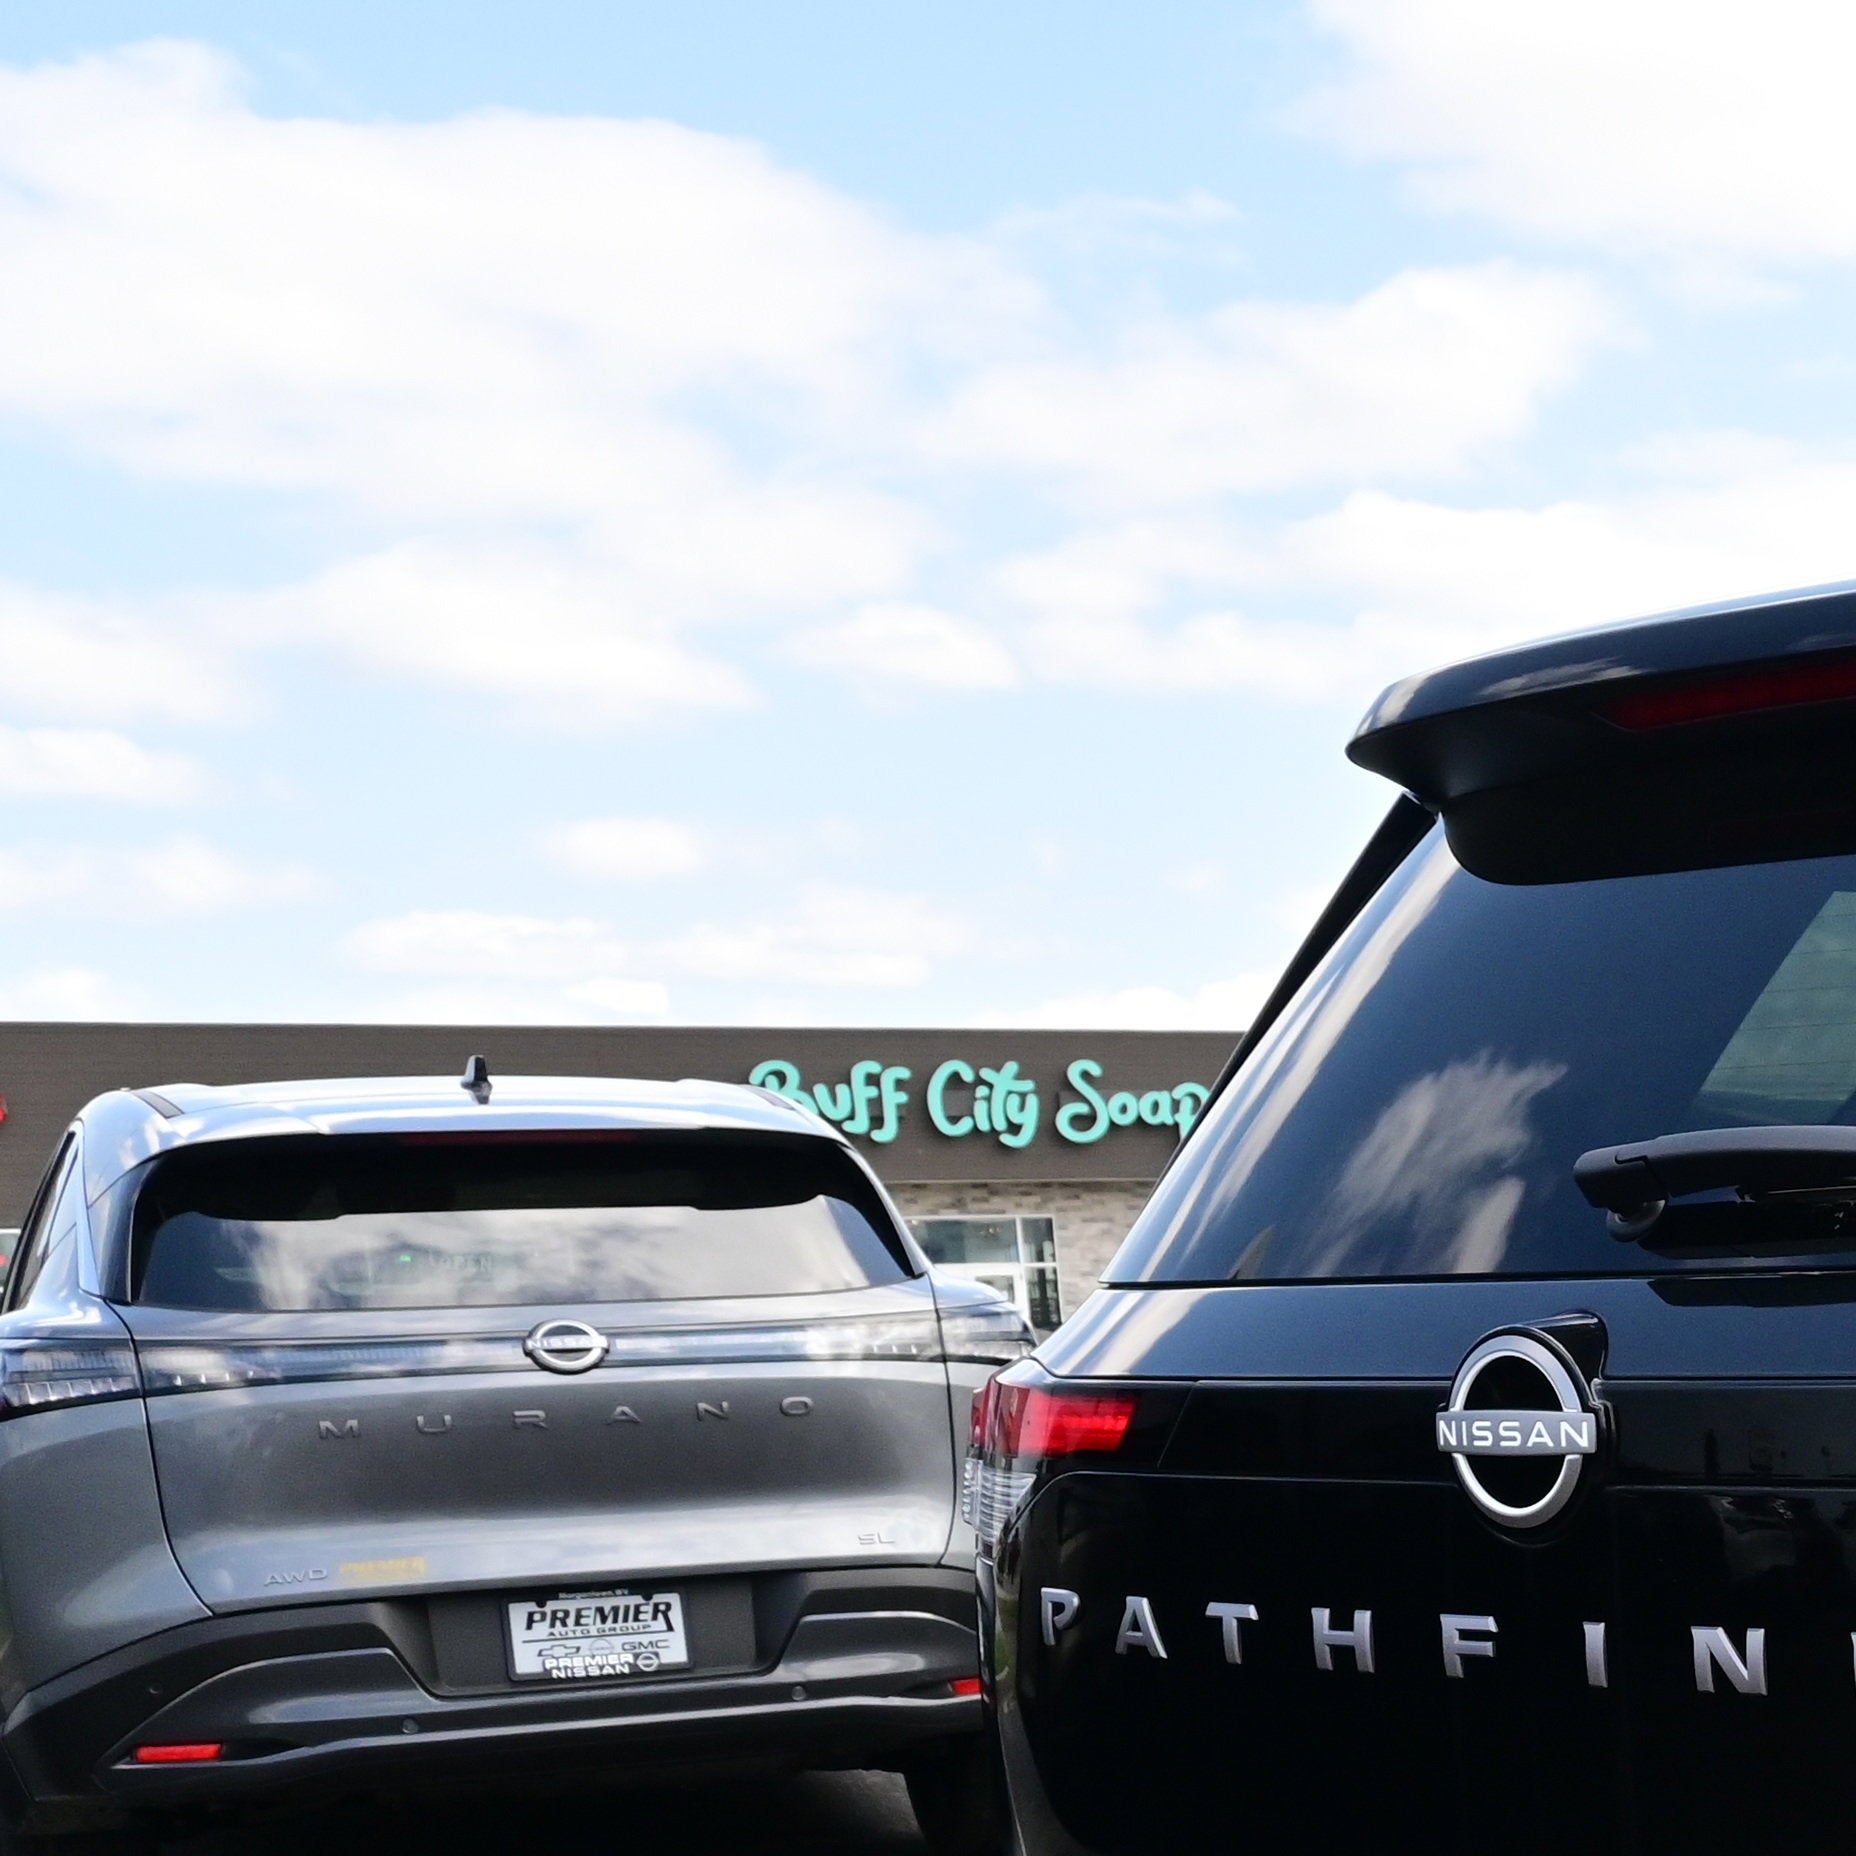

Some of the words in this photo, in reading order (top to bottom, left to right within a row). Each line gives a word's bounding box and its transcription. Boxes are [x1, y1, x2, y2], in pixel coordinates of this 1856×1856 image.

[926, 1059, 1039, 1148] City
[1055, 1059, 1210, 1144] Soap
[317, 1395, 815, 1440] MURANO
[1438, 1418, 1590, 1448] NISSAN
[857, 1531, 896, 1546] SL
[264, 1567, 329, 1587] AWD
[525, 1602, 674, 1632] PREMIER
[547, 1627, 591, 1637] AUTO
[596, 1624, 652, 1635] GROUP
[621, 1639, 671, 1652] GMC
[544, 1653, 634, 1670] PREMIER
[551, 1664, 630, 1679] NISSAN
